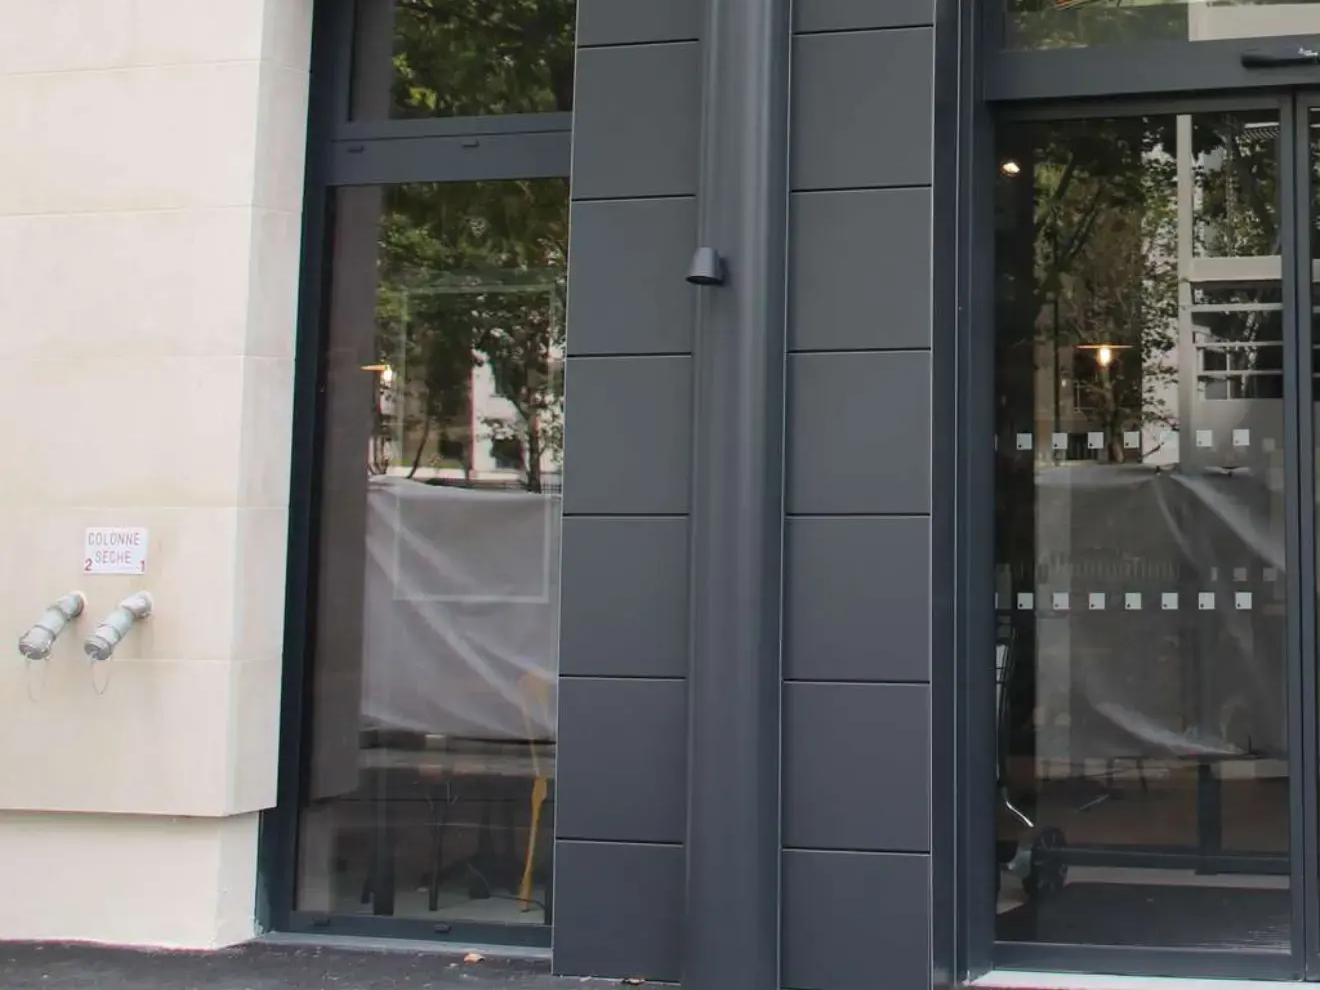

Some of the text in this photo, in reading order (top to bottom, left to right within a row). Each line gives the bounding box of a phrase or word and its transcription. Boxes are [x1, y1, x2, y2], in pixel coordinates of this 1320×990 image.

[88, 532, 140, 546] COLONNE
[84, 558, 93, 571] 2
[140, 560, 145, 572] 1
